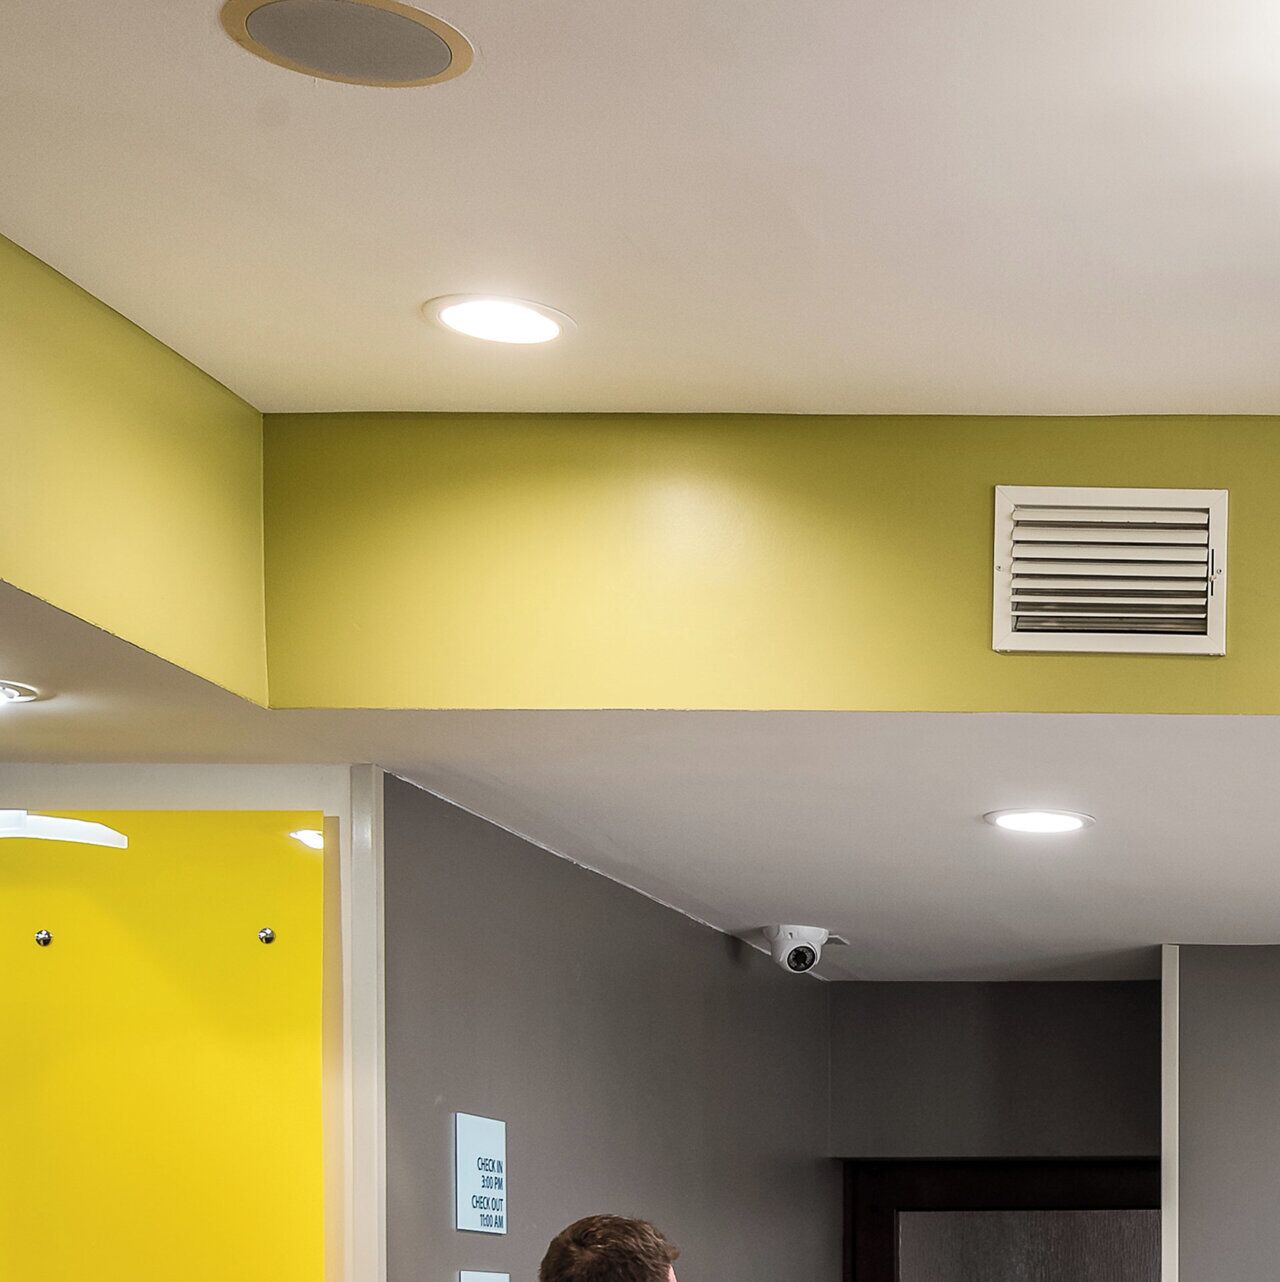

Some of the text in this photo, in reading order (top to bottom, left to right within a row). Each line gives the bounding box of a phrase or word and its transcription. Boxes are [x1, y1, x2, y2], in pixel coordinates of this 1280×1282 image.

[478, 1157, 503, 1173] CHECK IN
[481, 1175, 503, 1190] 3:00 PM
[472, 1195, 503, 1211] CHECK OUT
[480, 1213, 503, 1228] 11:00 AM
